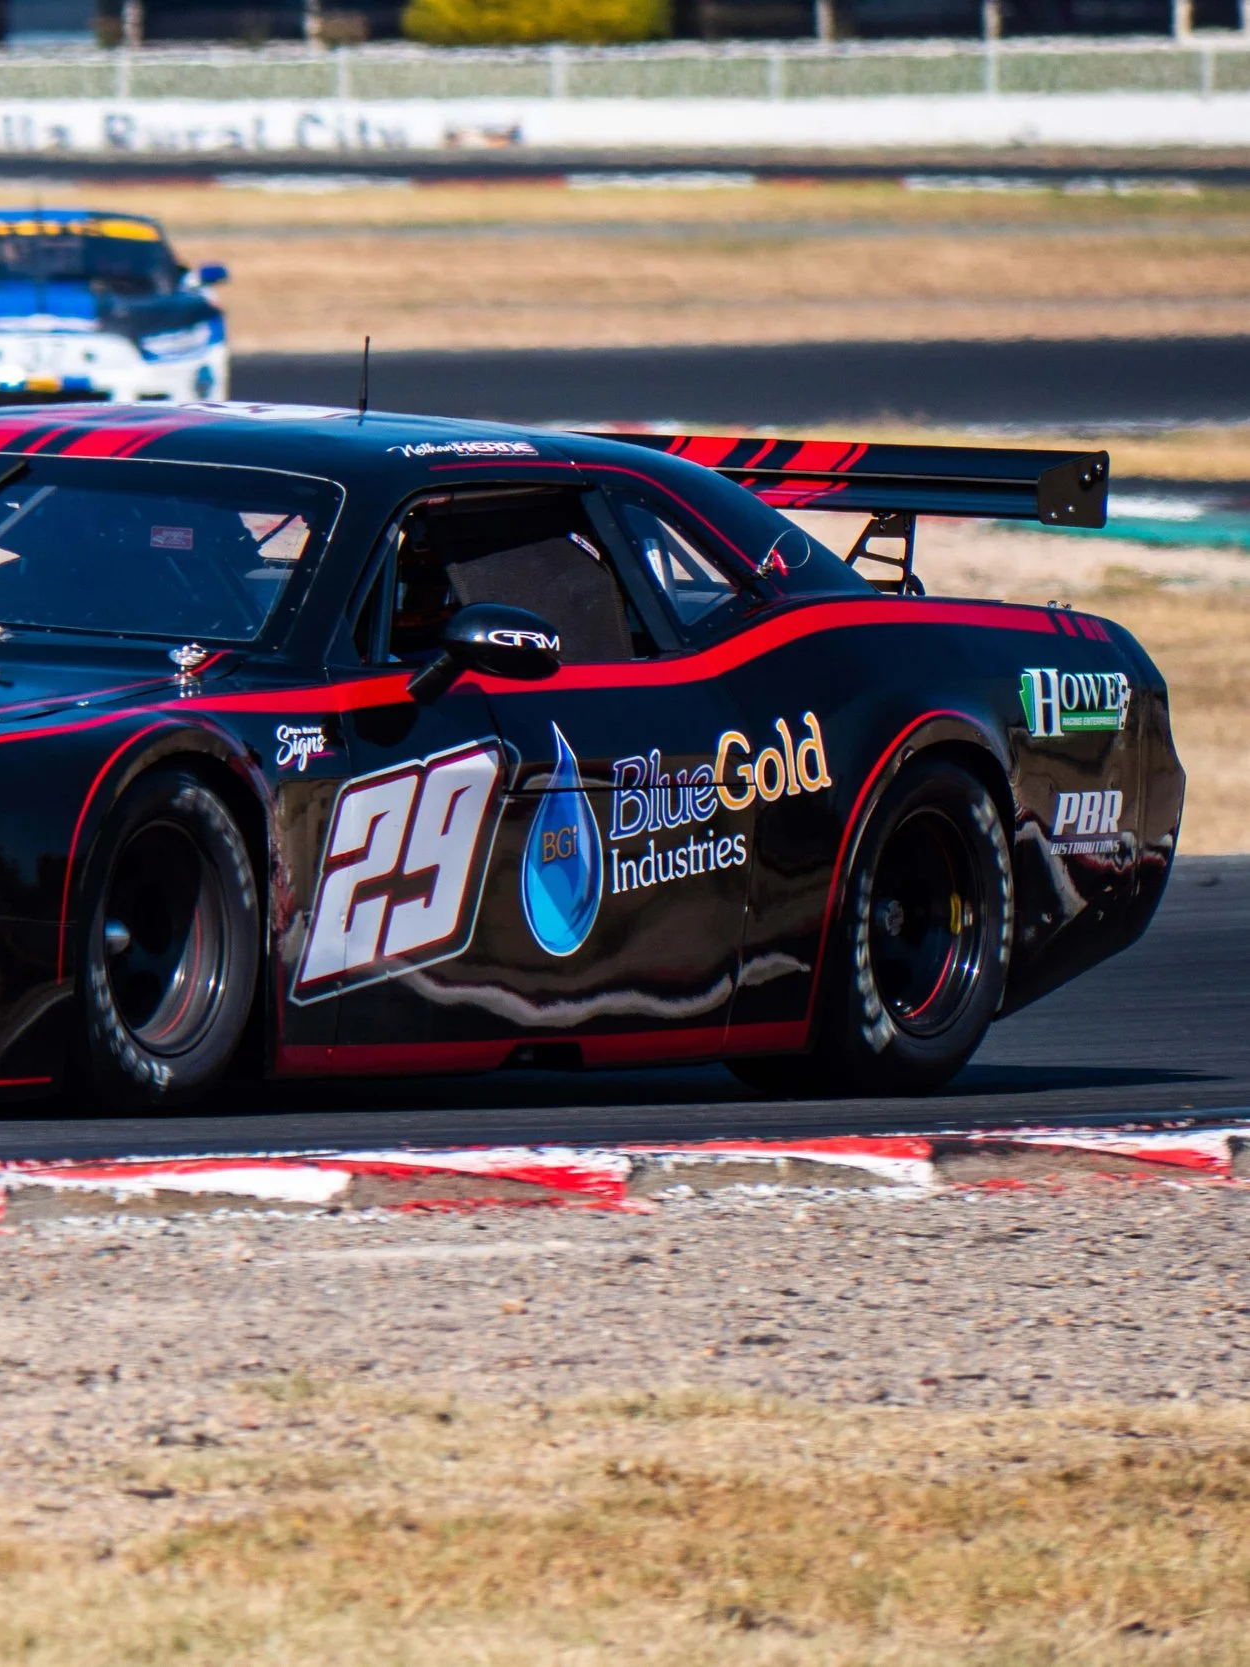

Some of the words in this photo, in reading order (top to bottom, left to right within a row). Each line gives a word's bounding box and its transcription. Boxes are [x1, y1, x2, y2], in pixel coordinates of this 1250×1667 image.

[276, 724, 327, 771] Signs
[1053, 790, 1123, 835] PBR
[296, 746, 503, 988] 29
[541, 825, 579, 864] BGi
[611, 833, 748, 894] Industries
[1050, 840, 1121, 855] DISTRIBUTIONS
